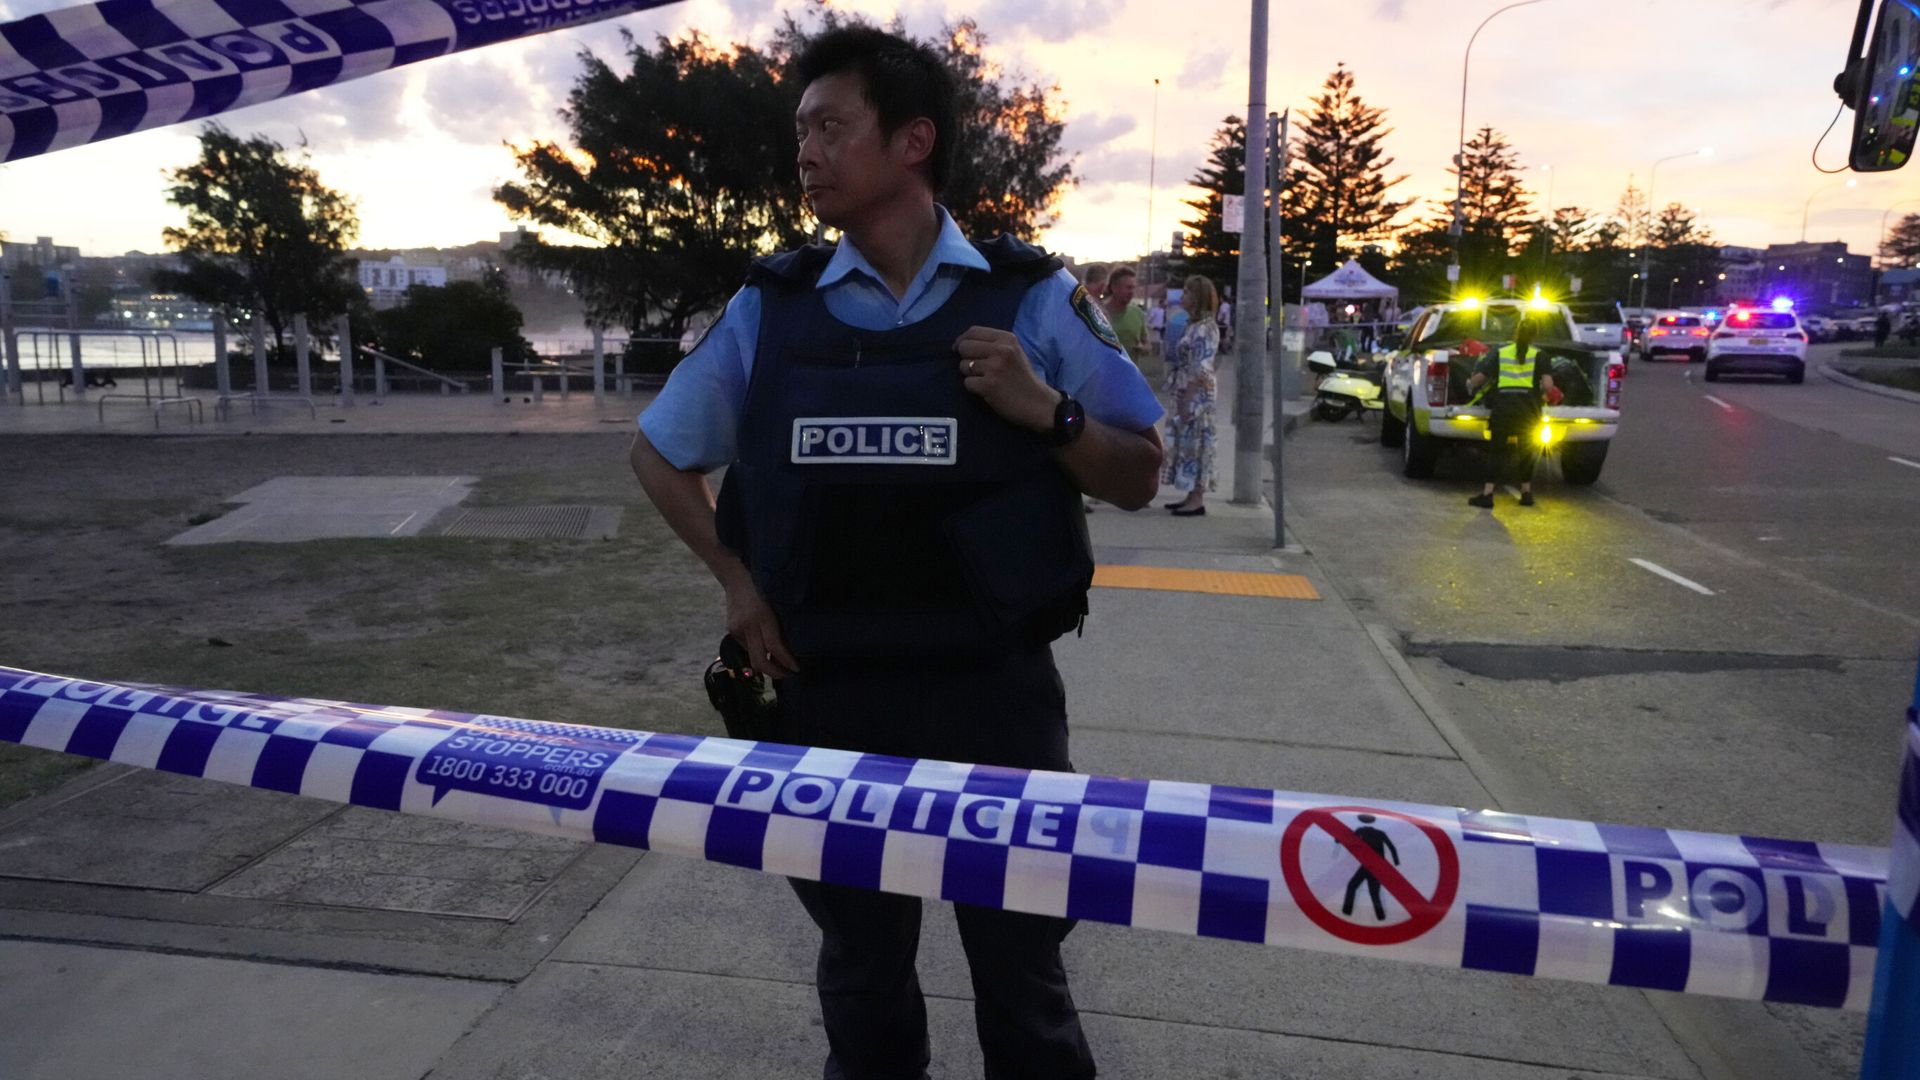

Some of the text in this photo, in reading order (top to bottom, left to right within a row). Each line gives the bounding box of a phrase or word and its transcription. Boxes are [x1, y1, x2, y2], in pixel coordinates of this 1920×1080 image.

[13, 22, 329, 99] POLICE
[801, 426, 947, 455] POLICE
[447, 736, 612, 768] STOPPERS
[426, 755, 588, 799] 1800 333 000
[727, 769, 1064, 849] POLICE
